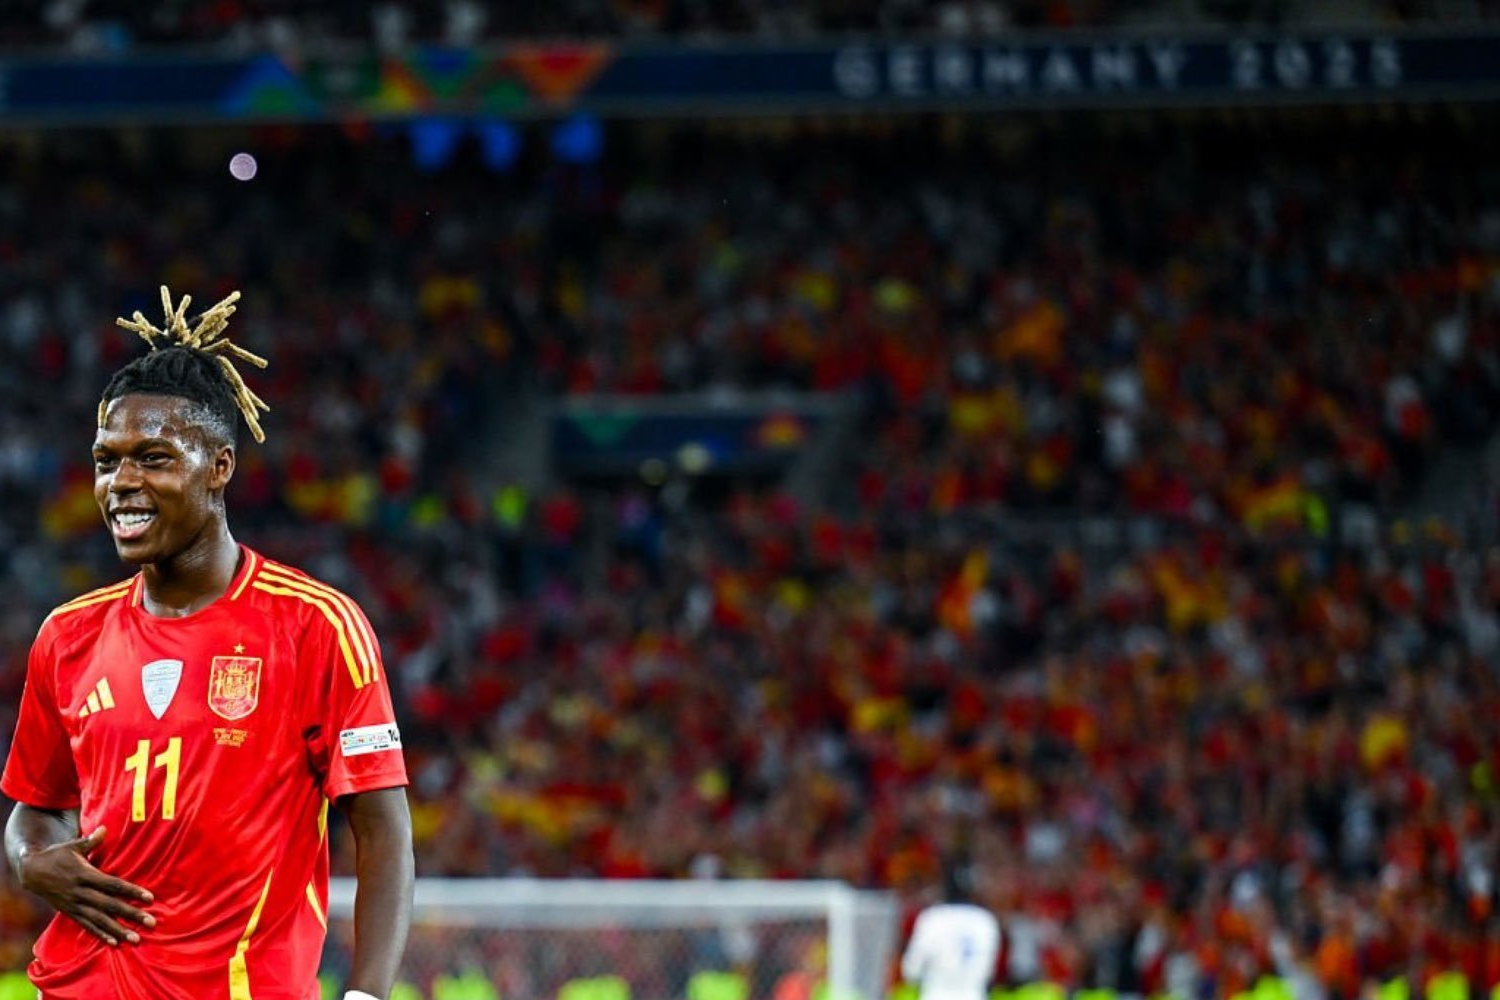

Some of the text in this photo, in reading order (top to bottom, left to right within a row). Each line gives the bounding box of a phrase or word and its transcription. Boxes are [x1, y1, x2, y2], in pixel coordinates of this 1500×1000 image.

[831, 38, 1405, 100] GERMANY 2025
[125, 737, 183, 823] 11
